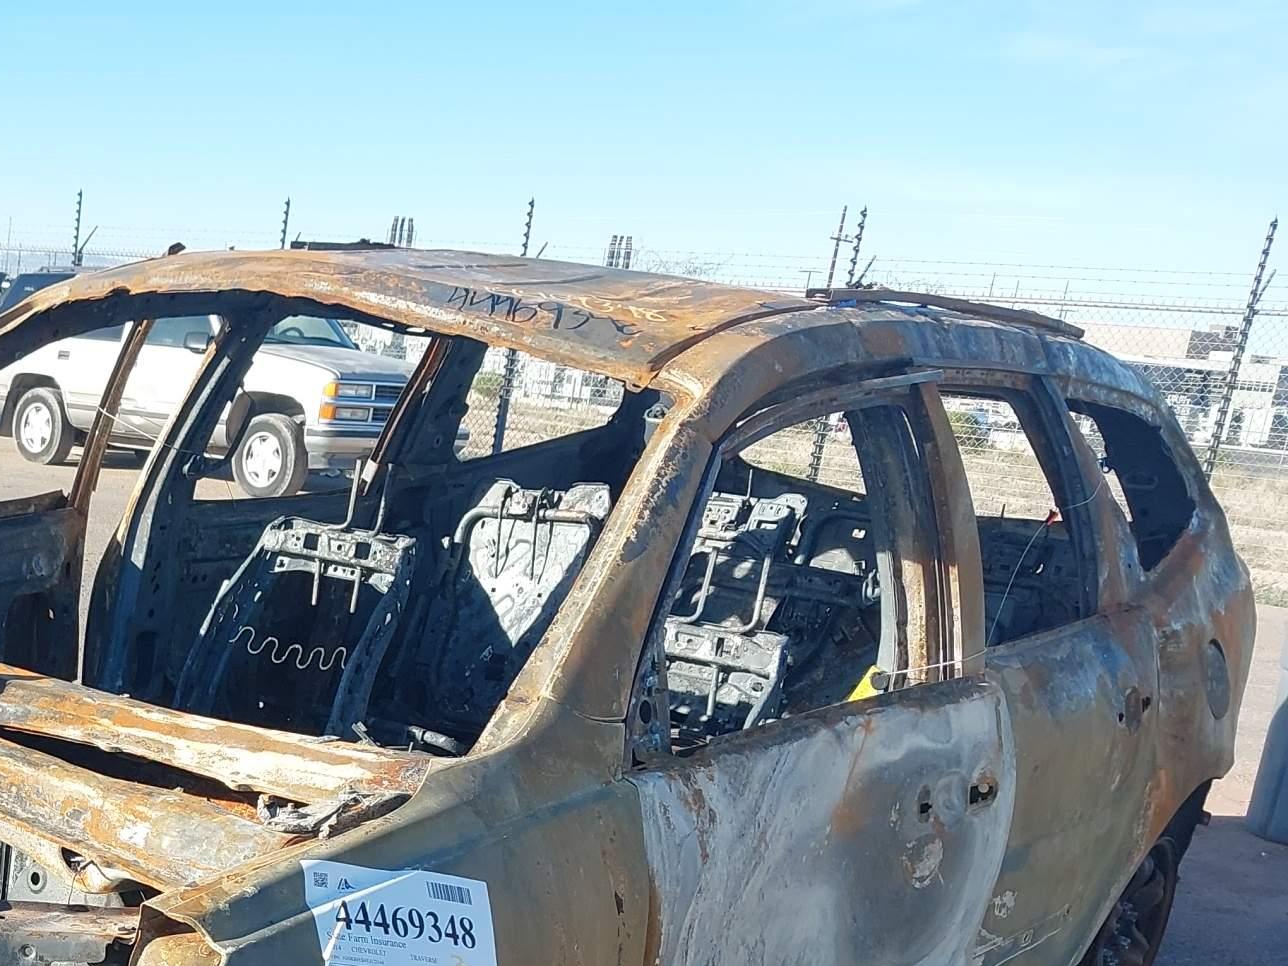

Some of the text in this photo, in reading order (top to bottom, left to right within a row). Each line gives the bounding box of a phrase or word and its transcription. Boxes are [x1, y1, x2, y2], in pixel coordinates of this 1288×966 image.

[335, 900, 476, 949] 44469348
[347, 932, 369, 944] Farm
[371, 935, 407, 949] Insurance
[351, 946, 387, 957] CHEVROLET
